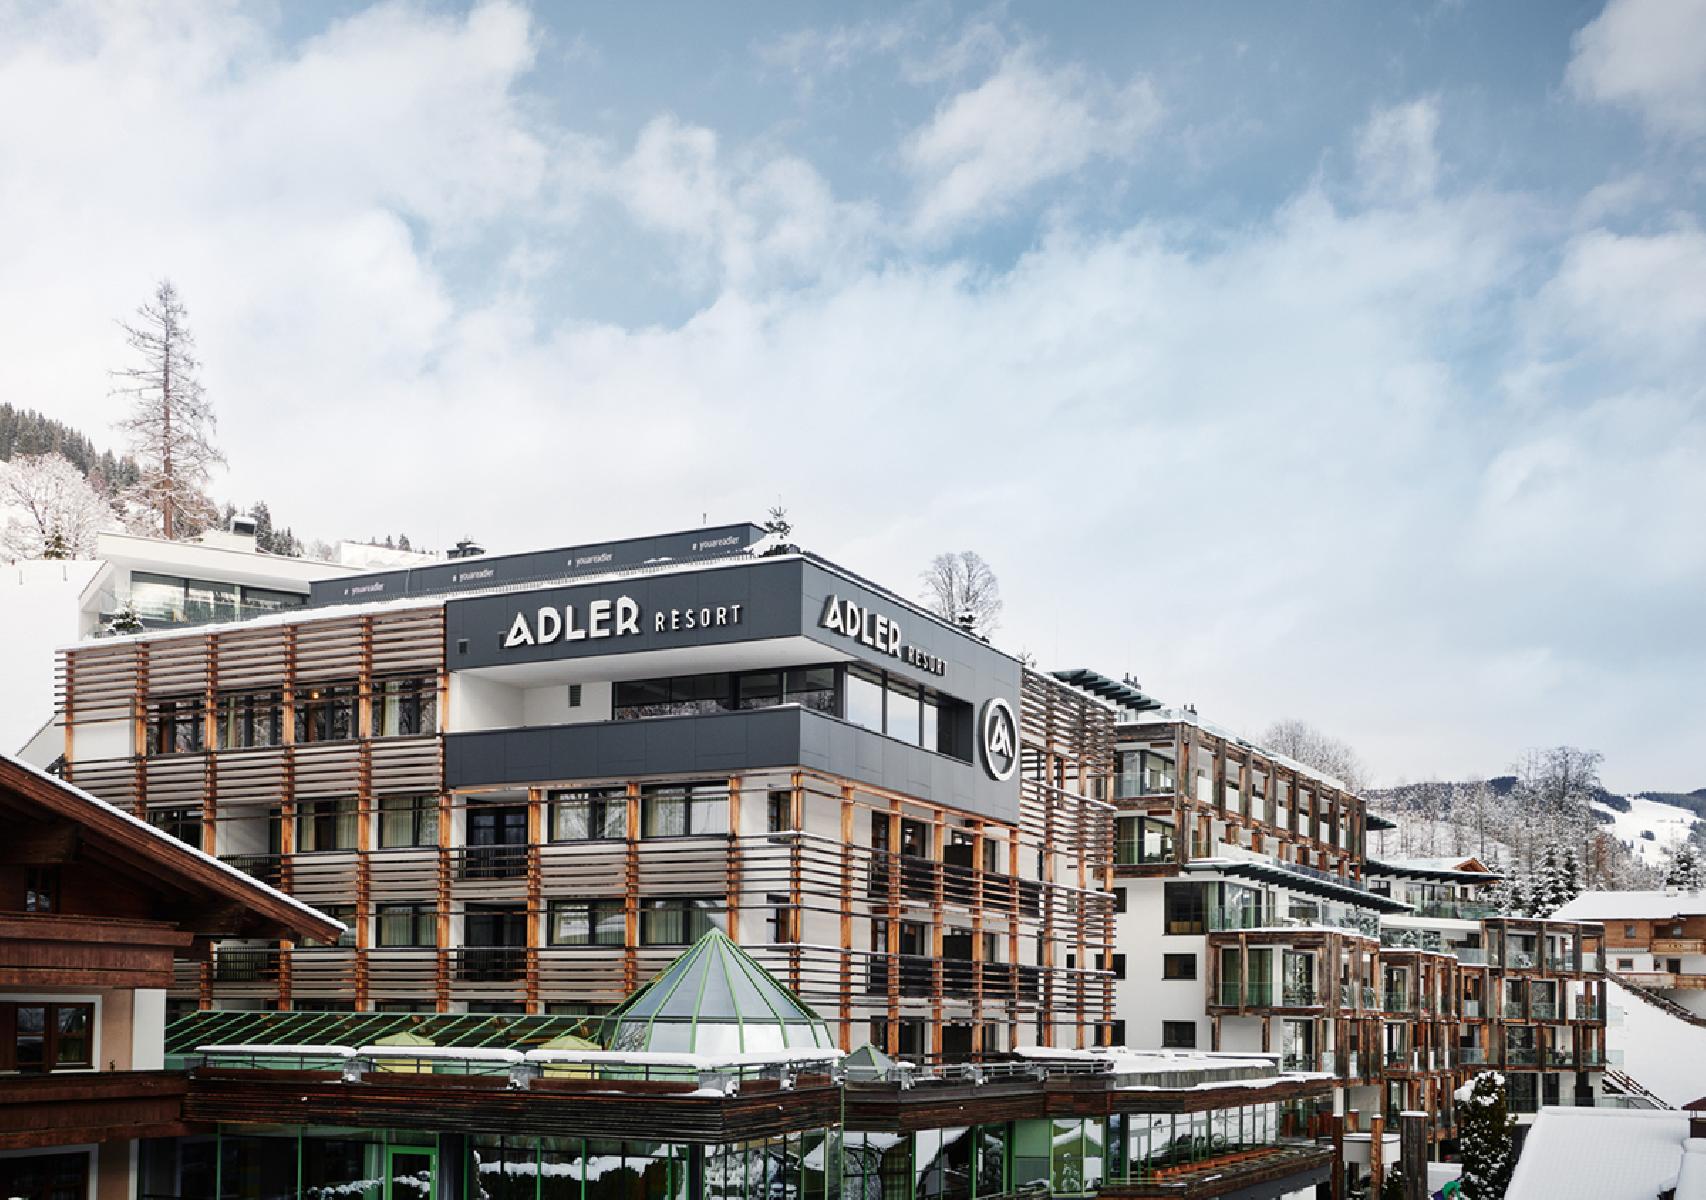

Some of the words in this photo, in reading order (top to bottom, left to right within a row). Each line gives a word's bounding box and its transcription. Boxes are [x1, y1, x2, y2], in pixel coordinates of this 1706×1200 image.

[503, 594, 641, 648] ADLER
[655, 604, 741, 632] RESORT
[820, 594, 902, 658] ADLER
[904, 645, 947, 677] RESORT
